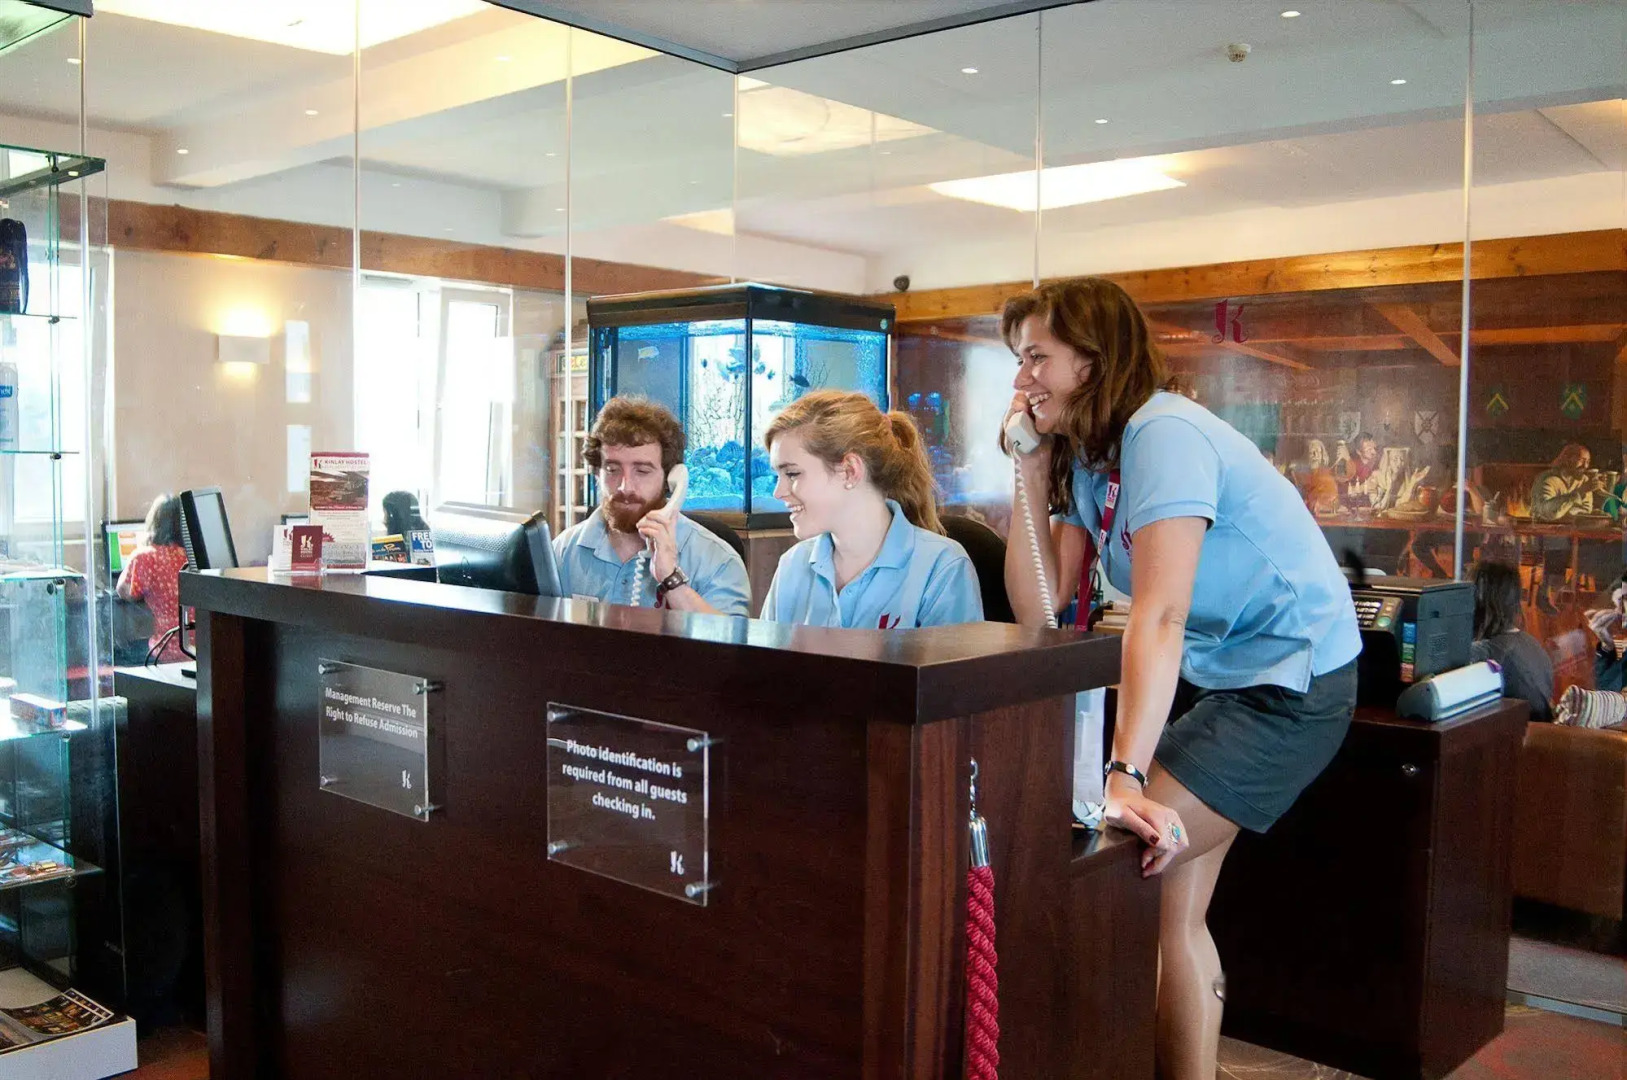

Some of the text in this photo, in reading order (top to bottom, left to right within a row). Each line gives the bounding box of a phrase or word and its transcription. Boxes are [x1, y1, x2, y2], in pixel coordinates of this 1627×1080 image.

[412, 531, 431, 541] FRE
[325, 687, 417, 718] Management Reserve The
[325, 706, 418, 738] Right to Refuse Admission
[566, 739, 682, 778] Photo identification is
[562, 764, 687, 804] required from all guests
[592, 792, 656, 820] checking in.
